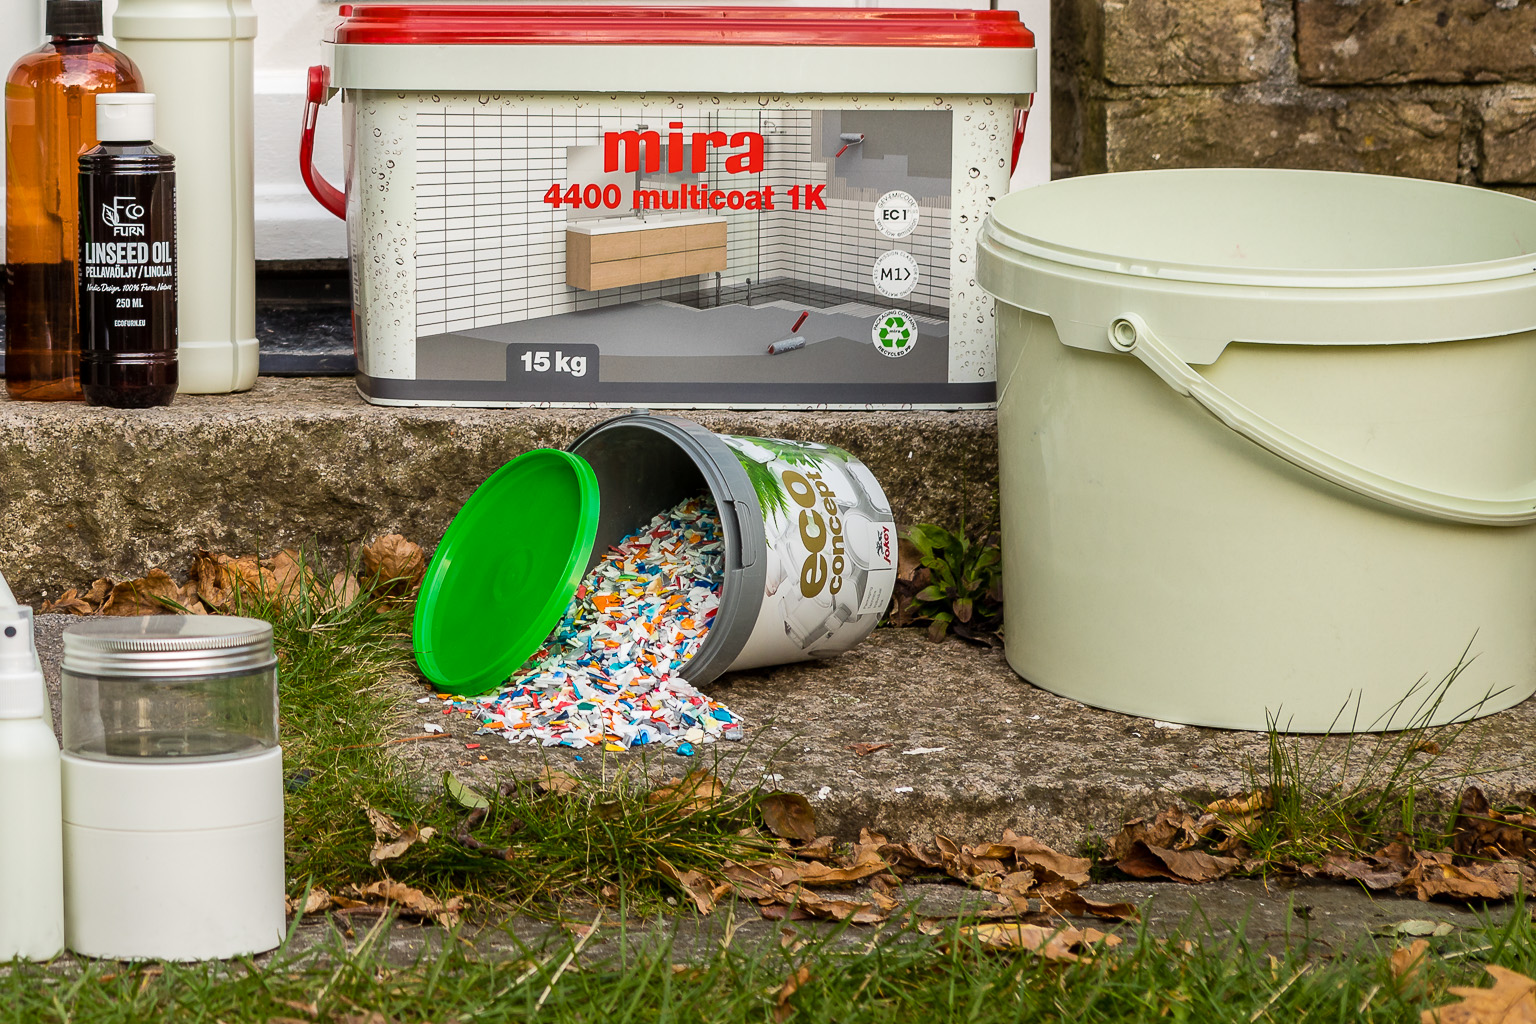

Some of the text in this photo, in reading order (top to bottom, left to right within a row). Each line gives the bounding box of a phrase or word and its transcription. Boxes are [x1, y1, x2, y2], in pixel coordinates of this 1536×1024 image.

[604, 122, 764, 174] mira
[544, 183, 827, 210] 4400 multicoat 1K
[883, 210, 899, 220] EC
[114, 226, 144, 236] FURN
[86, 242, 172, 264] LINSEED OIL
[86, 265, 137, 278] PELLAVAÖLJY
[144, 266, 172, 277] LINOLJA
[116, 298, 143, 308] 250 ML
[521, 351, 586, 377] 15 kg
[782, 470, 827, 598] eco
[805, 471, 844, 595] concept
